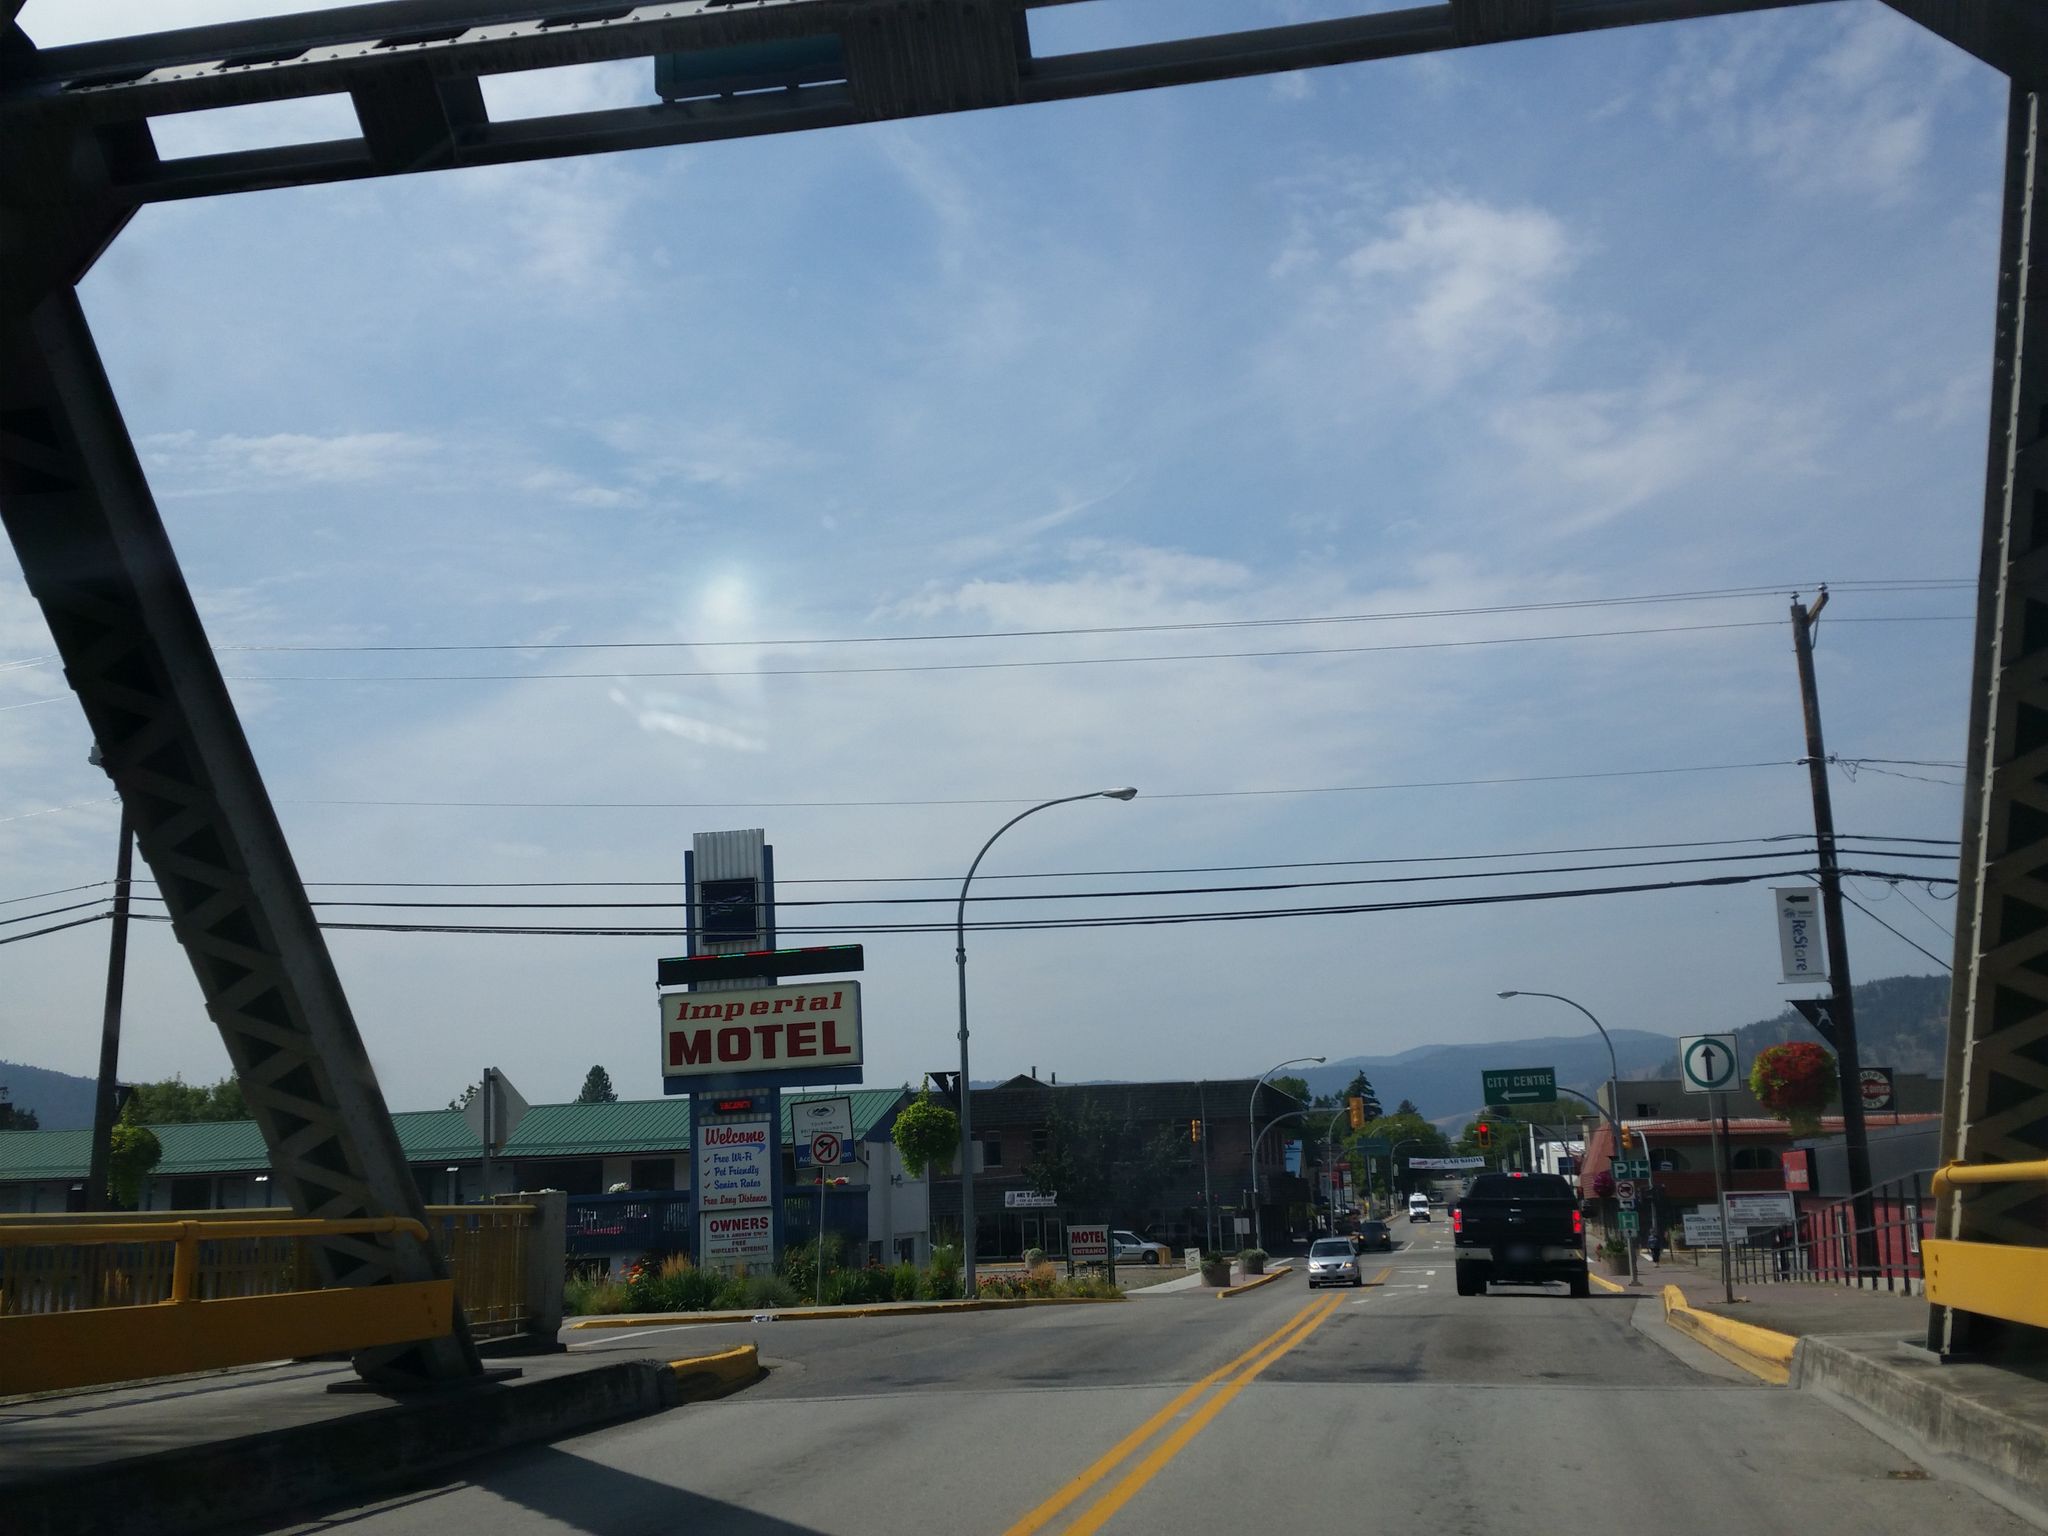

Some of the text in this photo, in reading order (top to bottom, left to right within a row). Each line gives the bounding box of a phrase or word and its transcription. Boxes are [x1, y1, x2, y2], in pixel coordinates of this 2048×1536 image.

[1792, 920, 1808, 971] ReStore
[676, 992, 842, 1021] Imperial
[669, 1020, 851, 1066] MOTEL
[1487, 1074, 1552, 1088] CITY CENTRE
[705, 1127, 766, 1145] Welcome
[713, 1151, 752, 1163] Free Wi-Fi
[714, 1165, 759, 1176] Pet Friendly
[1613, 1162, 1627, 1178] P
[714, 1178, 761, 1190] Senior Rates
[703, 1193, 768, 1206] Free Long Distance
[710, 1217, 769, 1233] OWNERS
[1623, 1214, 1637, 1228] H
[1071, 1231, 1106, 1243] MOTEL
[711, 1245, 768, 1254] WIRELESS INTERNET
